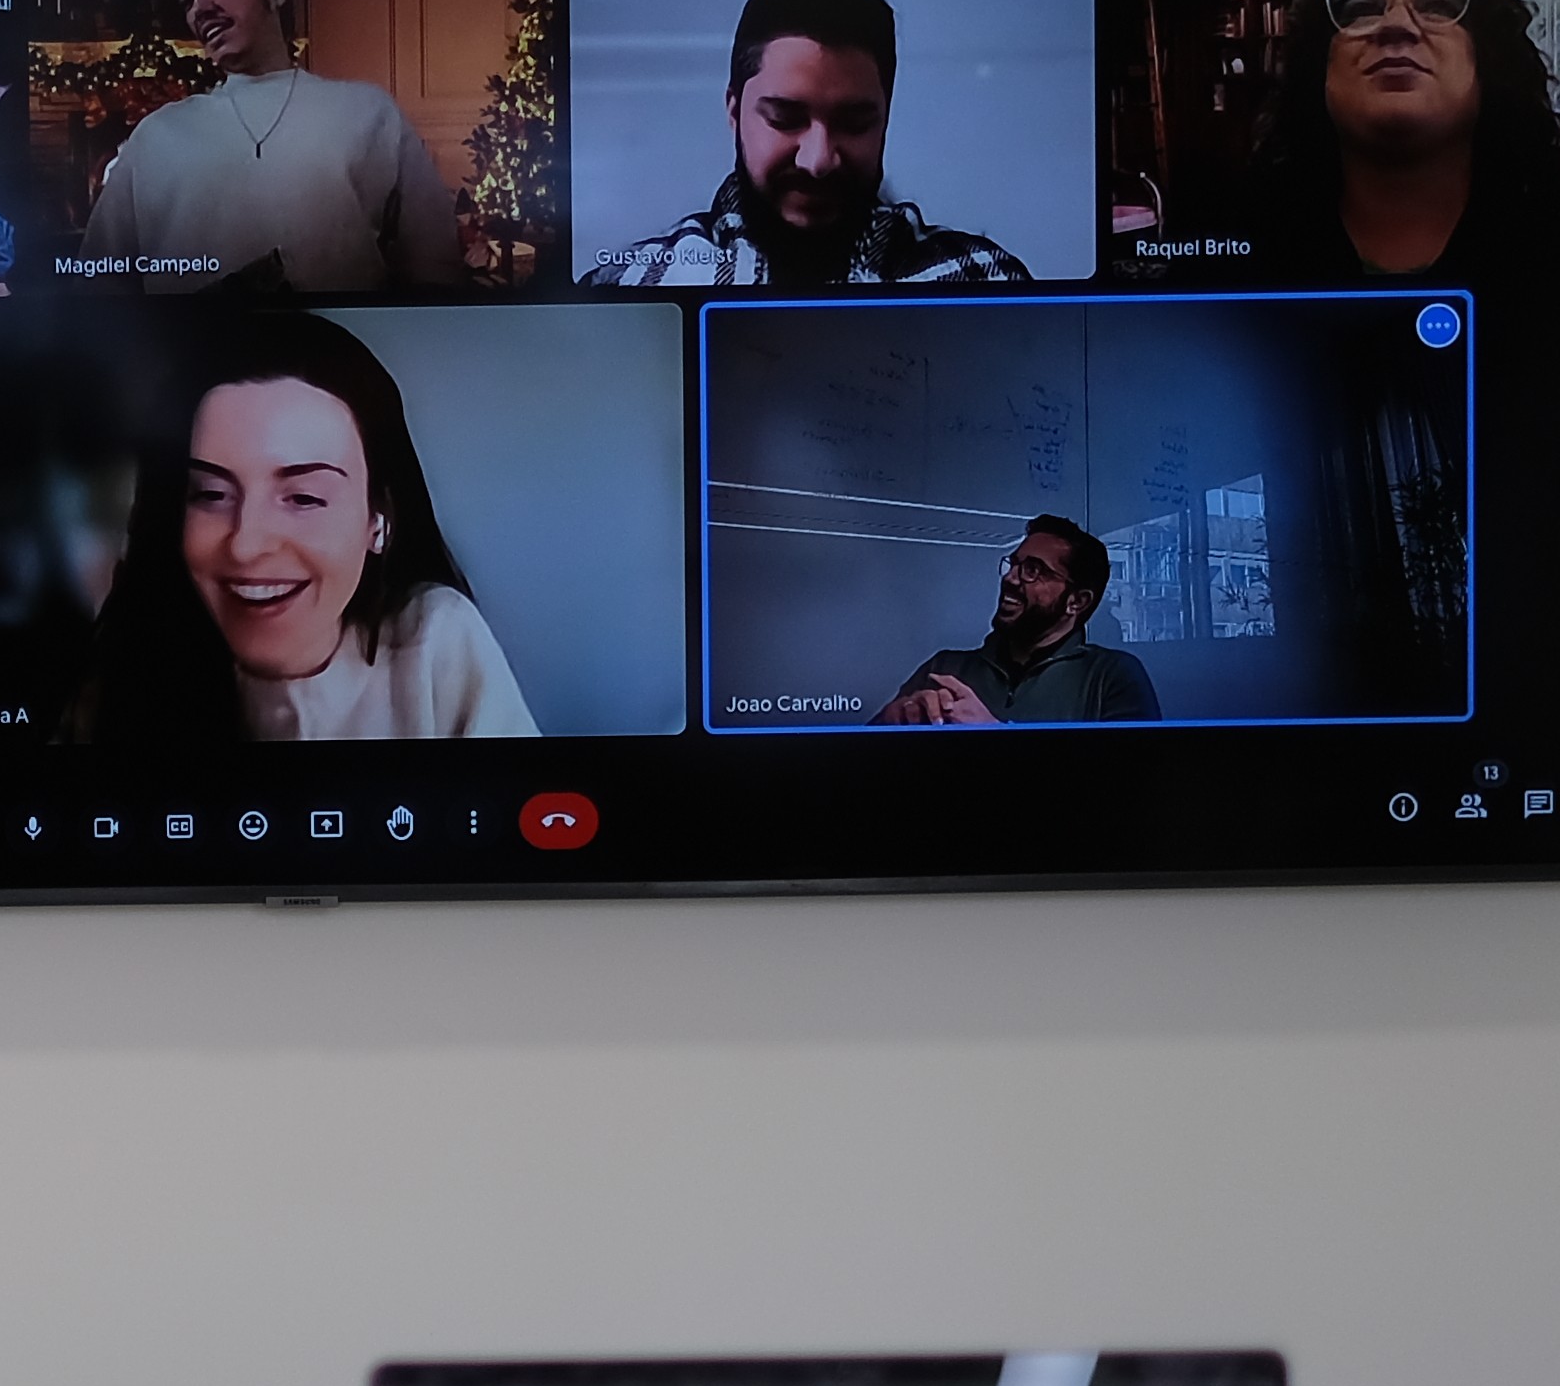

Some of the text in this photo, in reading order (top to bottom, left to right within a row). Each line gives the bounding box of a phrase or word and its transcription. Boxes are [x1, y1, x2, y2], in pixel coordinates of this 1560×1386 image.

[595, 248, 675, 264] Gustavo
[1136, 238, 1251, 260] Raquel Brito
[55, 254, 220, 278] Magdiel Campelo
[725, 694, 862, 713] Joao Carvalho
[15, 706, 29, 724] A
[1483, 765, 1499, 781] 13
